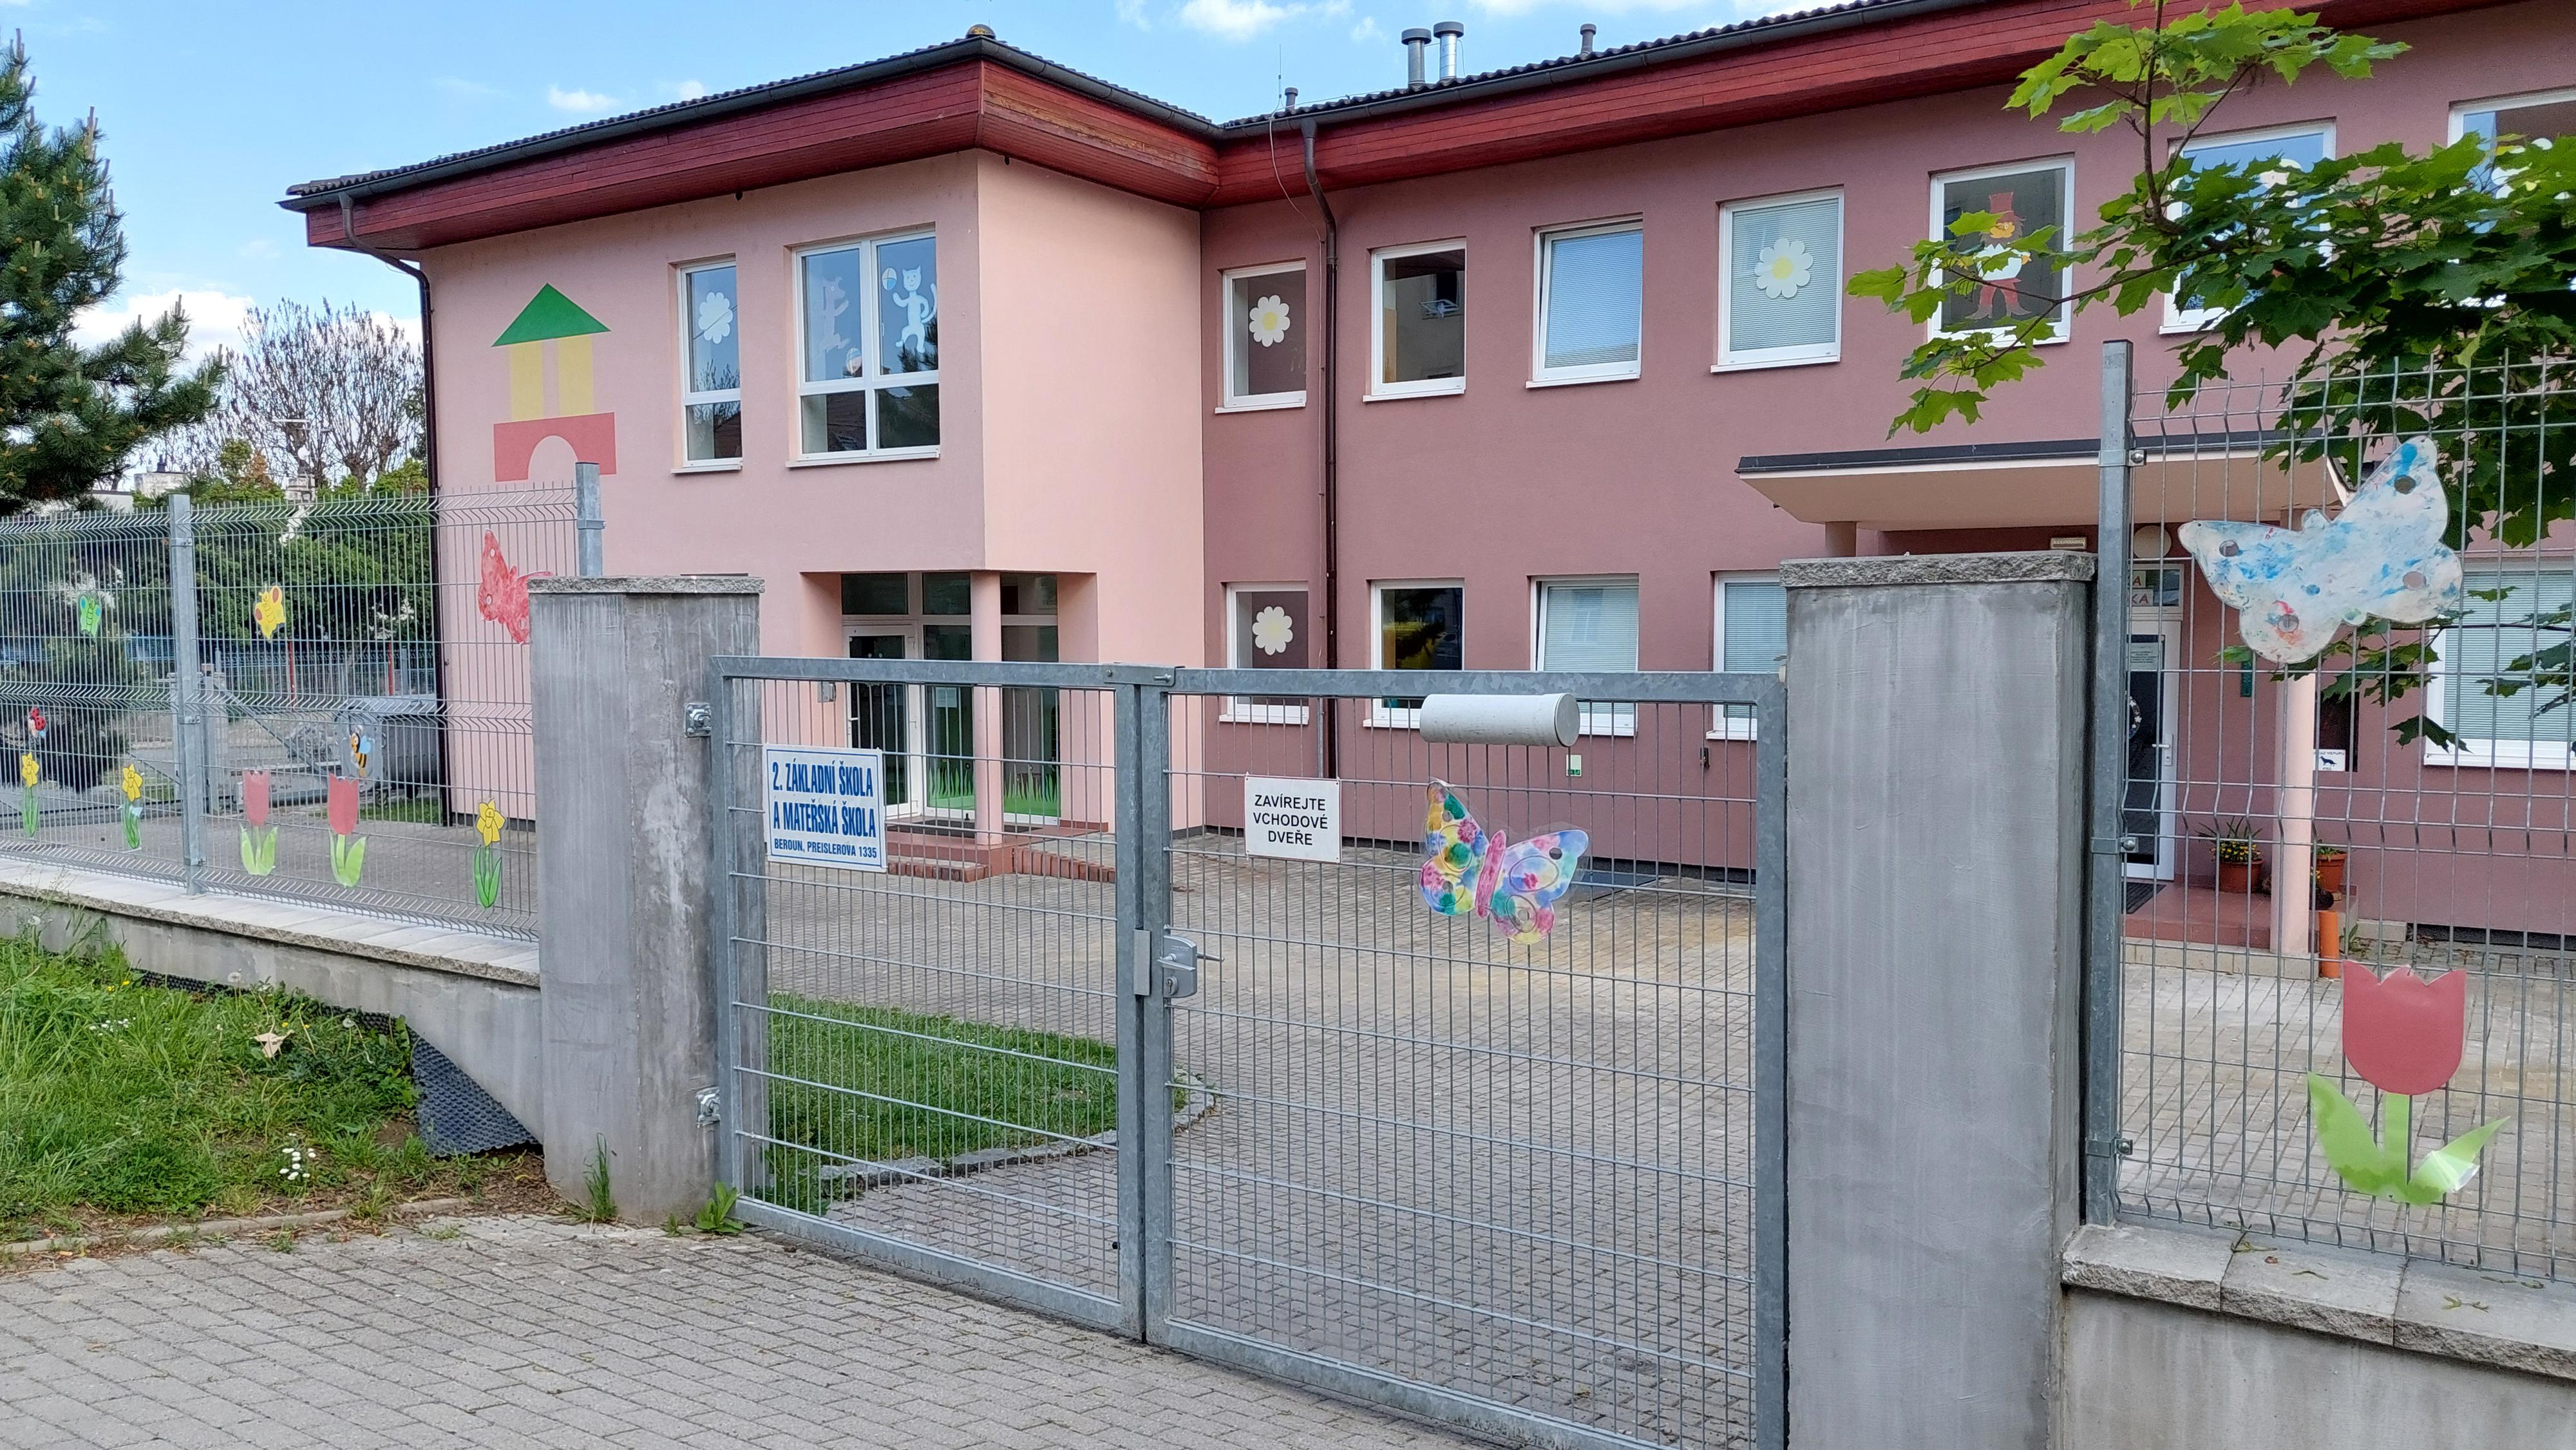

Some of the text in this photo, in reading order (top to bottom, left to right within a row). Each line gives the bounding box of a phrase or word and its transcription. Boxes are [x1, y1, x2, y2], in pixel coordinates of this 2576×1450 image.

[772, 758, 873, 797] 2. ZÁKLADNÍ ŠKOLA
[1255, 793, 1326, 811] ZAVÍREJTE
[773, 798, 876, 838] A MATEŘSKÁ ŠKOLA
[1253, 812, 1328, 829] VCHODOVÉ
[1268, 829, 1313, 846] DVEŘE
[774, 838, 877, 858] BEROUN, PREISLEROVA 1335
